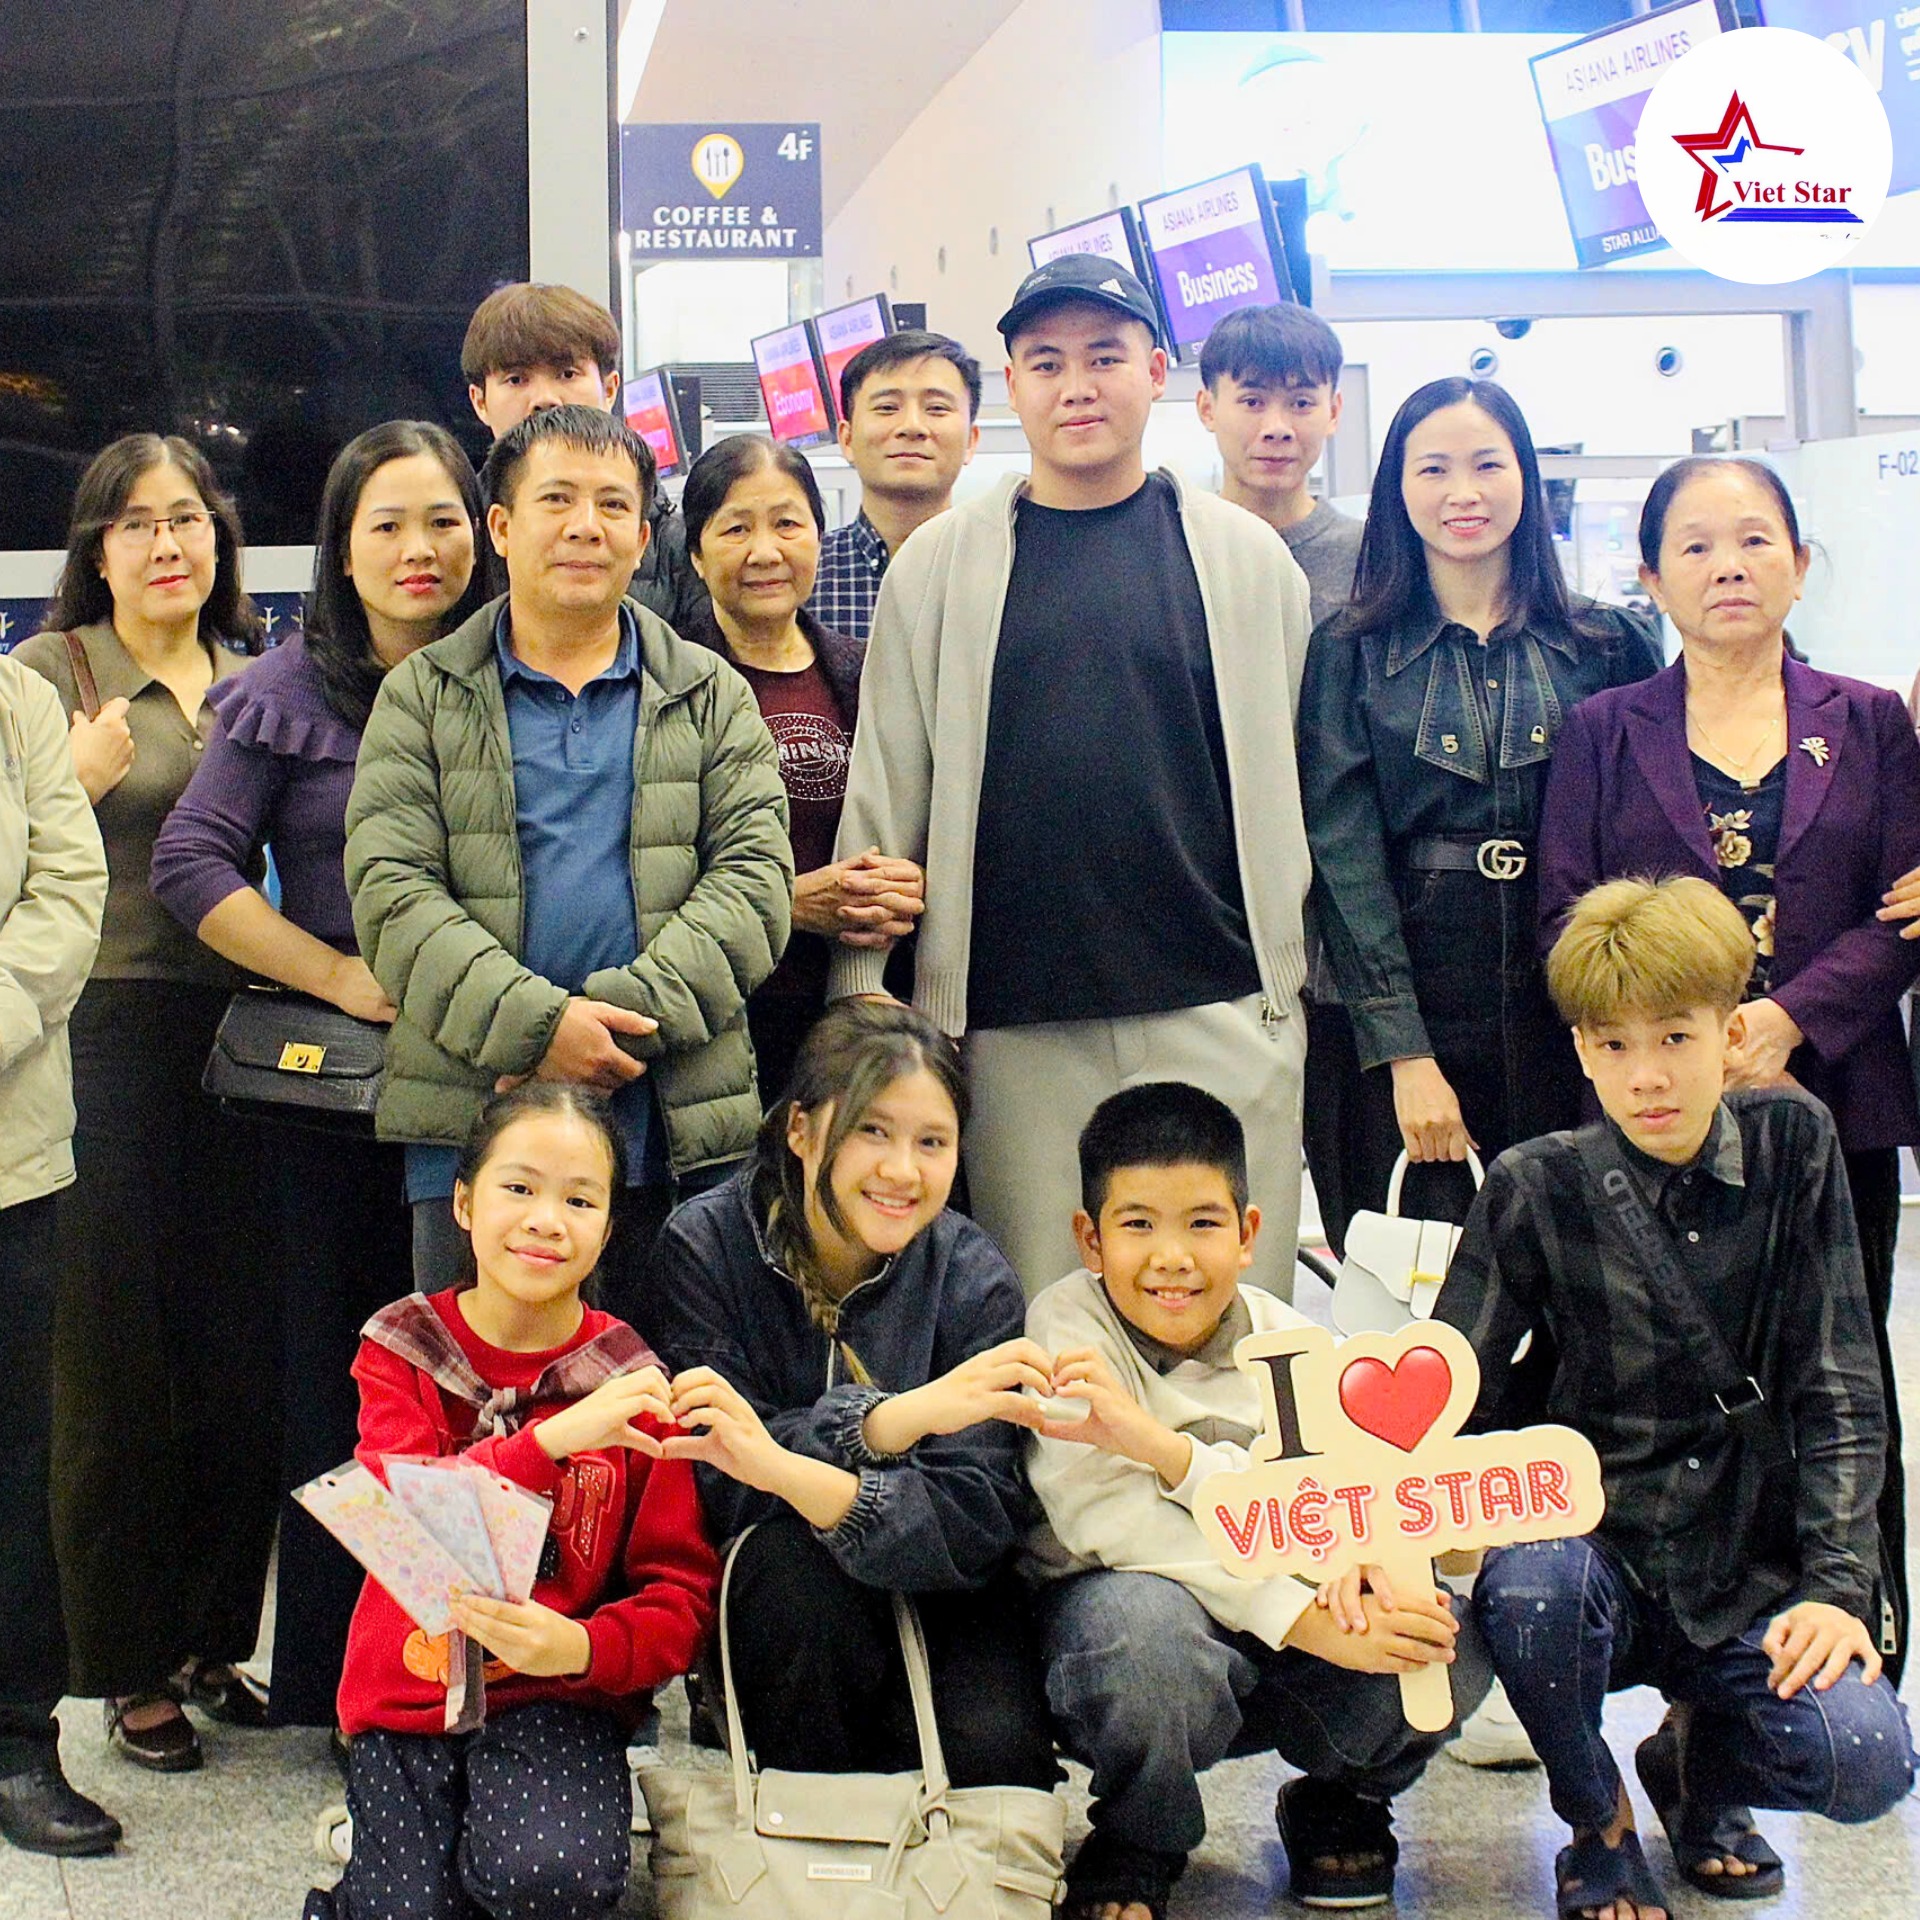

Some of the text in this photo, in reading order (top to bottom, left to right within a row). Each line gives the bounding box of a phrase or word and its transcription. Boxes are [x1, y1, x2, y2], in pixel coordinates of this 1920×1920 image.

[1565, 29, 1692, 96] ASIANA AIRLINES
[777, 131, 813, 161] 4F
[1584, 140, 1637, 192] Bus
[652, 205, 779, 227] COFFEE &
[634, 228, 798, 250] RESTAURANT
[1601, 231, 1633, 254] STAR
[1176, 262, 1259, 309] Business
[1878, 450, 1919, 480] F-02
[1441, 734, 1459, 754] 5
[1247, 1349, 1326, 1463] I
[1214, 1459, 1570, 1559] VIỆT STAR
